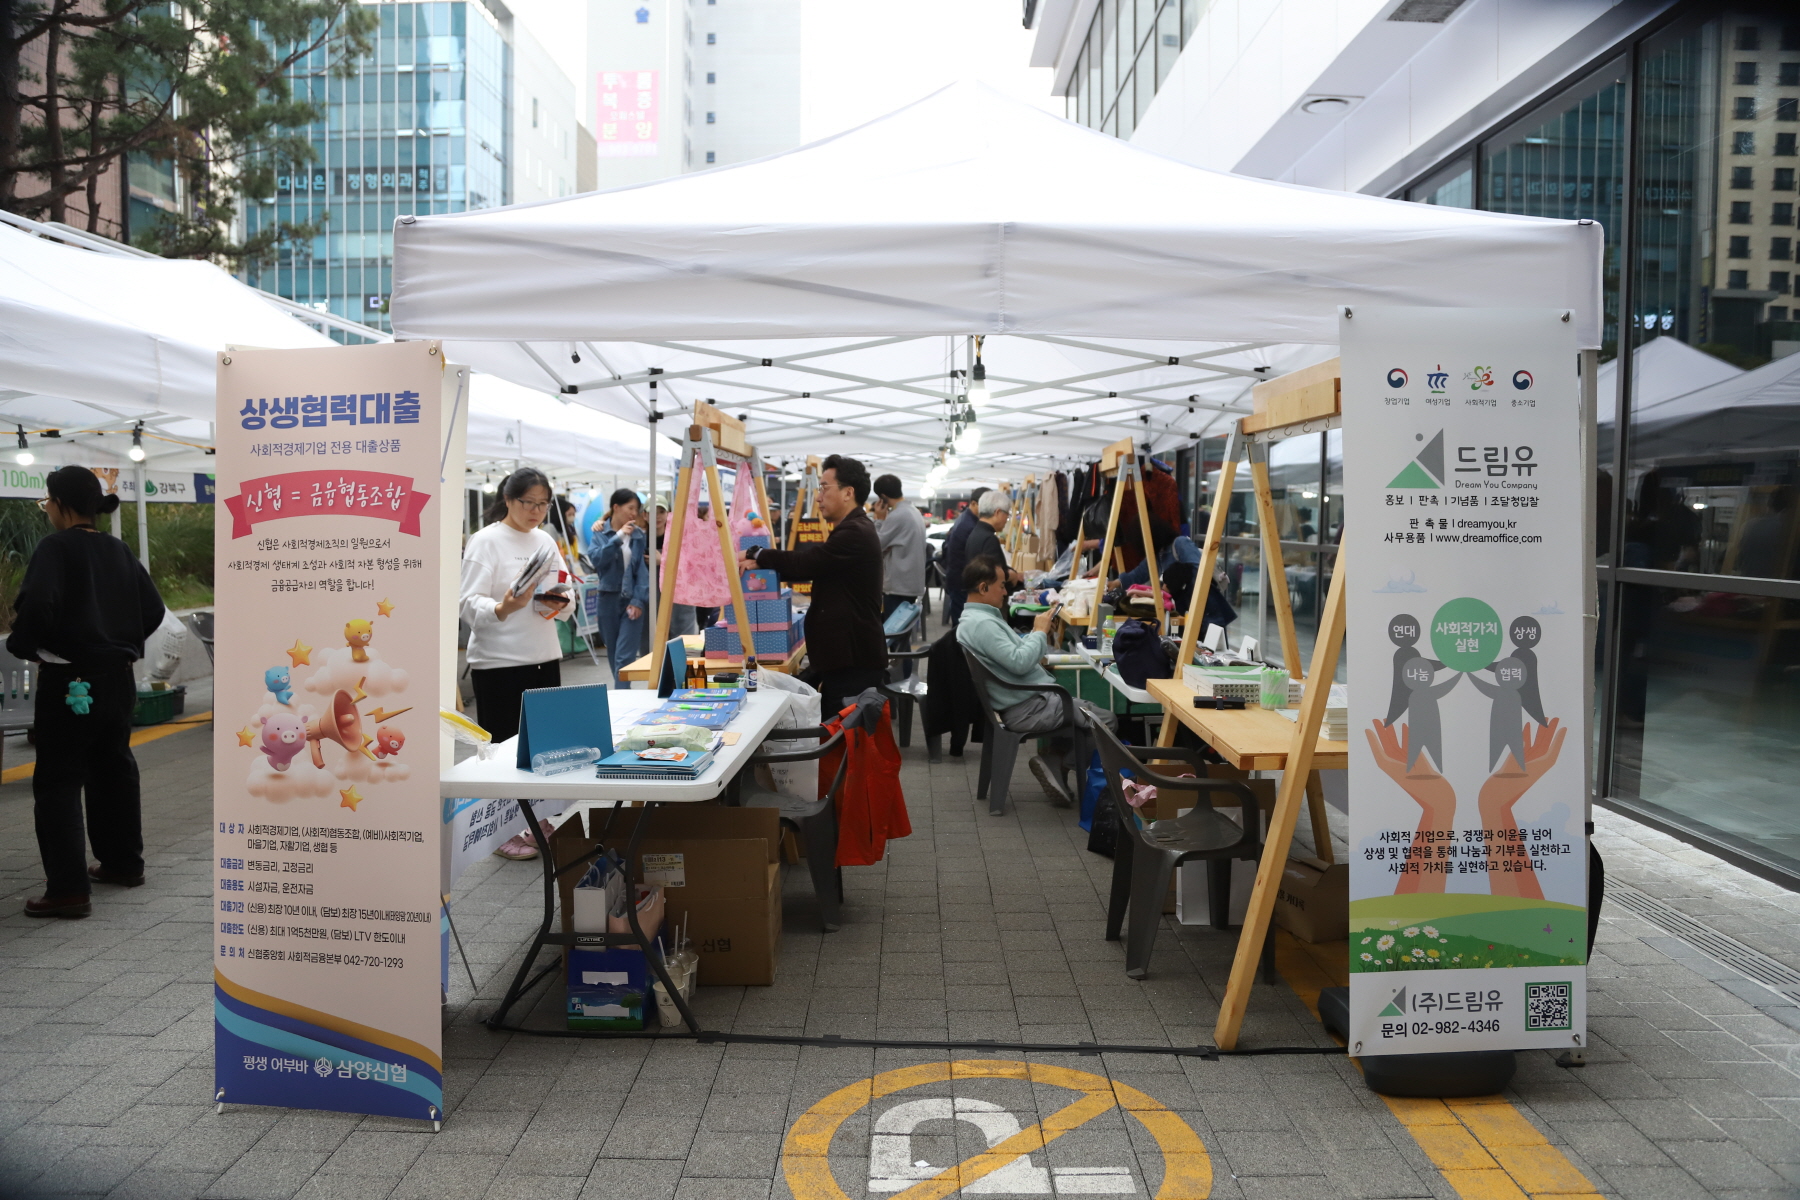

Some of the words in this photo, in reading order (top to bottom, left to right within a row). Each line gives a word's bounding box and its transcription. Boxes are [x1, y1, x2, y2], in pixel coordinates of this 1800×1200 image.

[347, 172, 412, 190] 정형외과
[239, 390, 421, 430] 상생협력대출
[250, 442, 327, 457] 사회적경제기업
[330, 440, 352, 454] 전용
[356, 439, 401, 454] 대출상품
[1454, 445, 1538, 477] 드림유
[159, 482, 186, 494] 강북구
[1455, 480, 1482, 489] Dream
[1483, 480, 1500, 489] You
[1501, 480, 1538, 490] Company
[246, 483, 282, 513] 신협
[310, 477, 406, 511] 금융협동조합
[1385, 494, 1405, 506] 홍보
[1418, 495, 1440, 506] 판촉
[1450, 495, 1479, 507] 기념품
[1490, 495, 1540, 508] 조달청입찰
[1457, 518, 1517, 531] dreamyou.kr
[257, 538, 280, 551] 신협은
[282, 538, 348, 550] 사회적경제조직의
[351, 538, 391, 550] 일원으로서
[1384, 532, 1426, 544] 사무용품
[1435, 533, 1542, 544] www.dreamoffice.com
[228, 559, 270, 572] 사회적경제
[272, 560, 300, 571] 생태계
[302, 560, 327, 571] 조성과
[329, 559, 355, 570] 사회적
[358, 559, 374, 570] 자본
[377, 558, 400, 571] 형성을
[403, 559, 422, 569] 위해
[271, 579, 317, 592] 금융공급자의
[319, 578, 343, 592] 역할을
[346, 578, 375, 592] 합니다!
[1393, 625, 1416, 639] 연대
[1435, 621, 1498, 636] 사회적가치
[1513, 626, 1537, 640] 상생
[1455, 638, 1480, 653] 실현
[1406, 668, 1430, 682] 나눔
[1500, 667, 1522, 681] 협력
[247, 824, 301, 838] 사회적경제기업,
[1379, 830, 1411, 844] 사회적
[1414, 829, 1459, 843] 기업으로,
[1462, 829, 1494, 843] 경쟁과
[1497, 829, 1528, 841] 이윤을
[1531, 828, 1552, 841] 넘어
[247, 839, 279, 851] 마을기업,
[280, 840, 312, 853] 자활기업,
[313, 842, 328, 853] 생협
[330, 843, 338, 853] 등
[1363, 847, 1385, 861] 상생
[1388, 847, 1398, 860] 및
[1402, 845, 1433, 859] 협력을
[1436, 845, 1458, 858] 통해
[1460, 844, 1493, 858] 나눔과
[1495, 844, 1526, 857] 기부를
[1529, 843, 1571, 856] 실천하고
[220, 858, 244, 870] 대출금리
[247, 860, 280, 873] 변동금리,
[282, 861, 314, 874] 고정금리
[1388, 861, 1420, 875] 사회적
[1423, 861, 1454, 874] 가치를
[1457, 860, 1499, 873] 실현하고
[1502, 859, 1547, 873] 있습니다.
[220, 879, 244, 891] 대출용도
[247, 880, 280, 894] 시설자금,
[282, 882, 314, 895] 운전자금
[220, 900, 244, 913] 대출기간
[247, 902, 267, 914] (신용)
[268, 903, 283, 915] 최장
[284, 904, 300, 916] 10년
[301, 905, 318, 918] 이내,
[320, 906, 341, 918] (담보)
[341, 907, 357, 919] 최장
[220, 922, 244, 935] 대출한도
[247, 924, 268, 936] (신용)
[269, 925, 286, 937] 최대
[287, 926, 329, 941] 1억5천만원,
[330, 928, 353, 941] (담보)
[354, 931, 372, 942] LTV
[373, 931, 406, 944] 한도이내
[702, 938, 732, 953] 신협
[247, 948, 286, 961] 신협중앙회
[287, 951, 342, 965] 사회적금융본부
[343, 954, 404, 969] 042-720-1293
[1412, 989, 1504, 1014] (주)드림유
[1381, 1022, 1408, 1039] 문의
[1412, 1019, 1501, 1035] 02-982-4346
[242, 1055, 268, 1070] 평생
[271, 1057, 309, 1075] 어부바
[335, 1060, 407, 1083] 삼양신협
